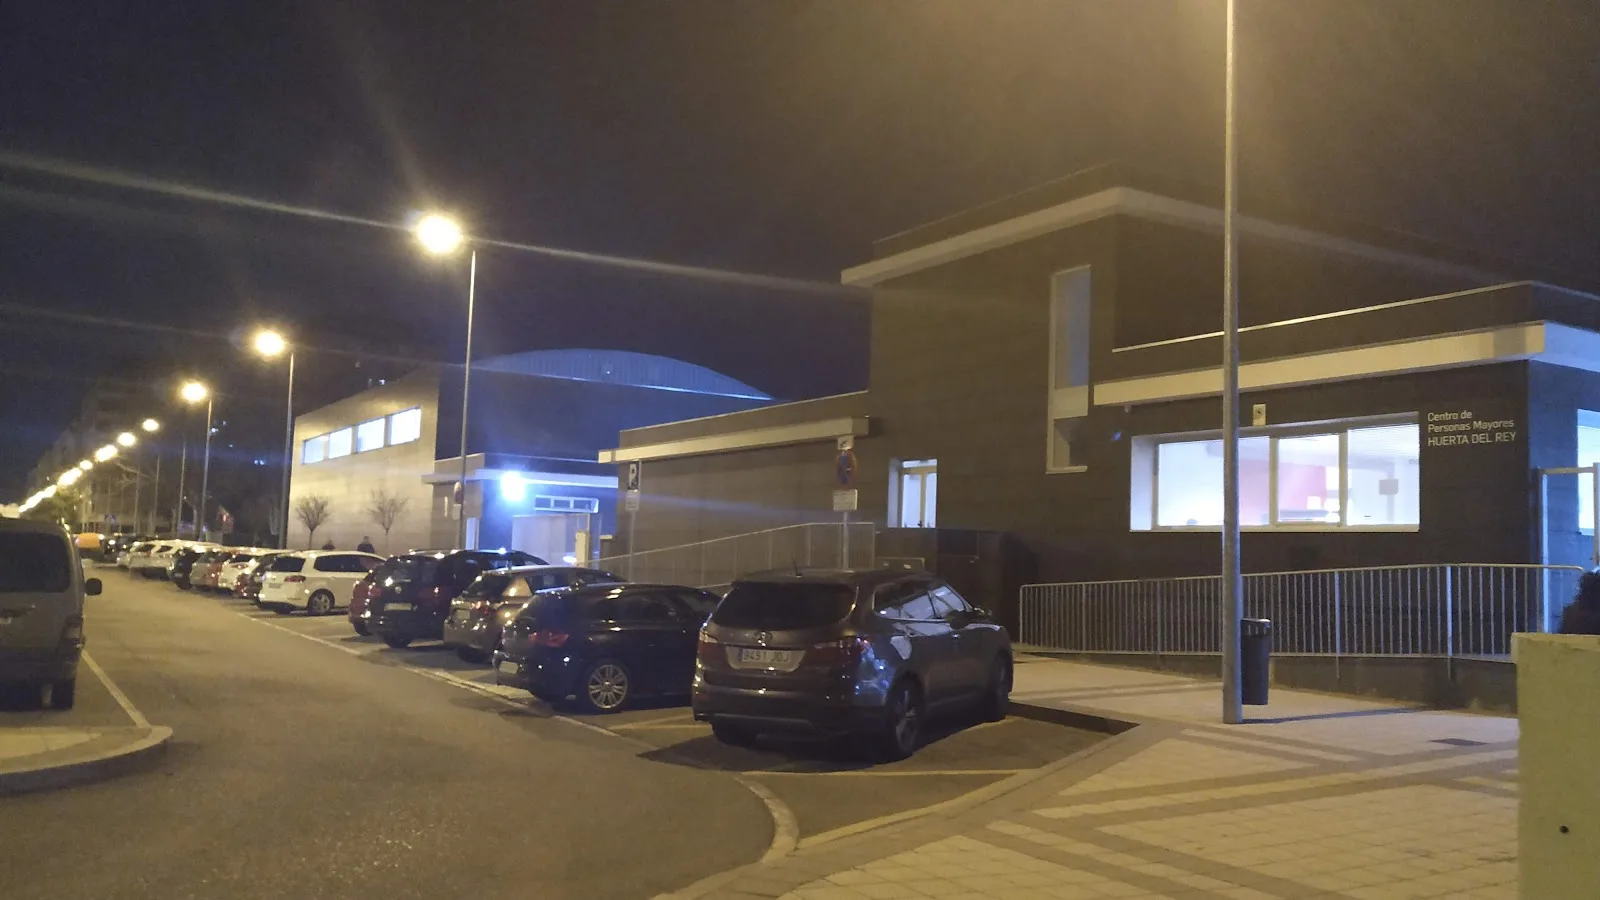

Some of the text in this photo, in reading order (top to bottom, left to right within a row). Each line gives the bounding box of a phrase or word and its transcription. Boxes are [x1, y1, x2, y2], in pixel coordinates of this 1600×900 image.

[1427, 410, 1473, 421] Centro de
[1428, 419, 1514, 433] Personas Mayores
[1427, 431, 1517, 447] HUERTA DEL REY
